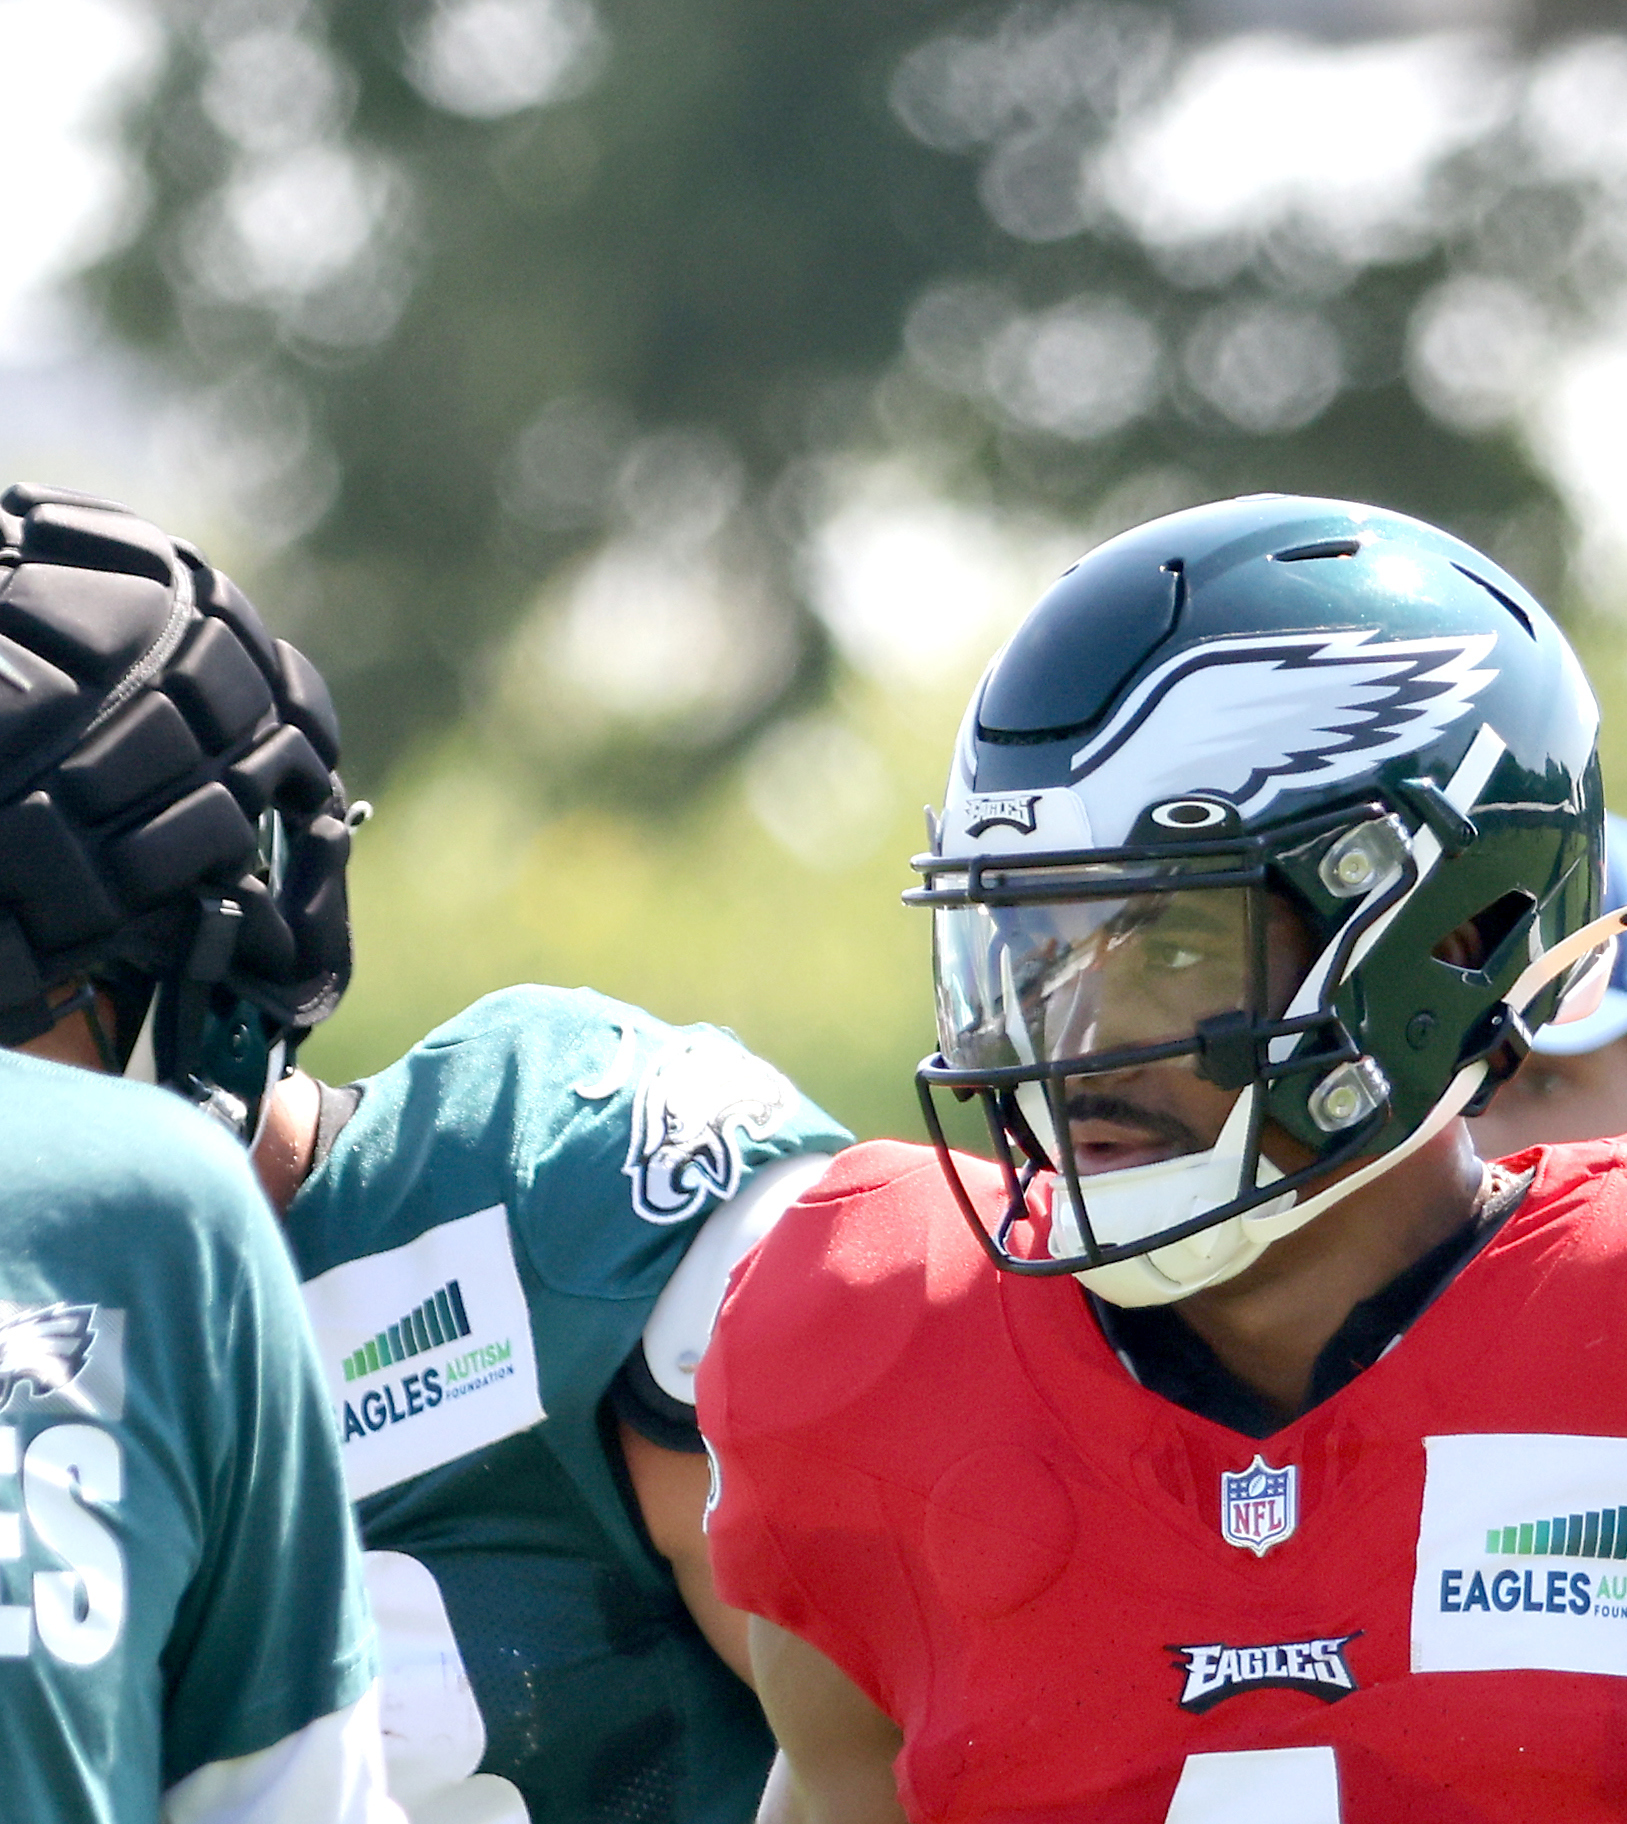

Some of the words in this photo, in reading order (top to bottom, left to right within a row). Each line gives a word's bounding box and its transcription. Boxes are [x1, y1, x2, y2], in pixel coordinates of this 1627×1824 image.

[342, 1366, 443, 1443] AGLES
[446, 1337, 512, 1384] AUTISM
[446, 1364, 515, 1400] FOUNDATION
[1233, 1499, 1282, 1537] NFL
[1440, 1569, 1591, 1616] EAGLES
[1177, 1637, 1352, 1704] EAGLES
